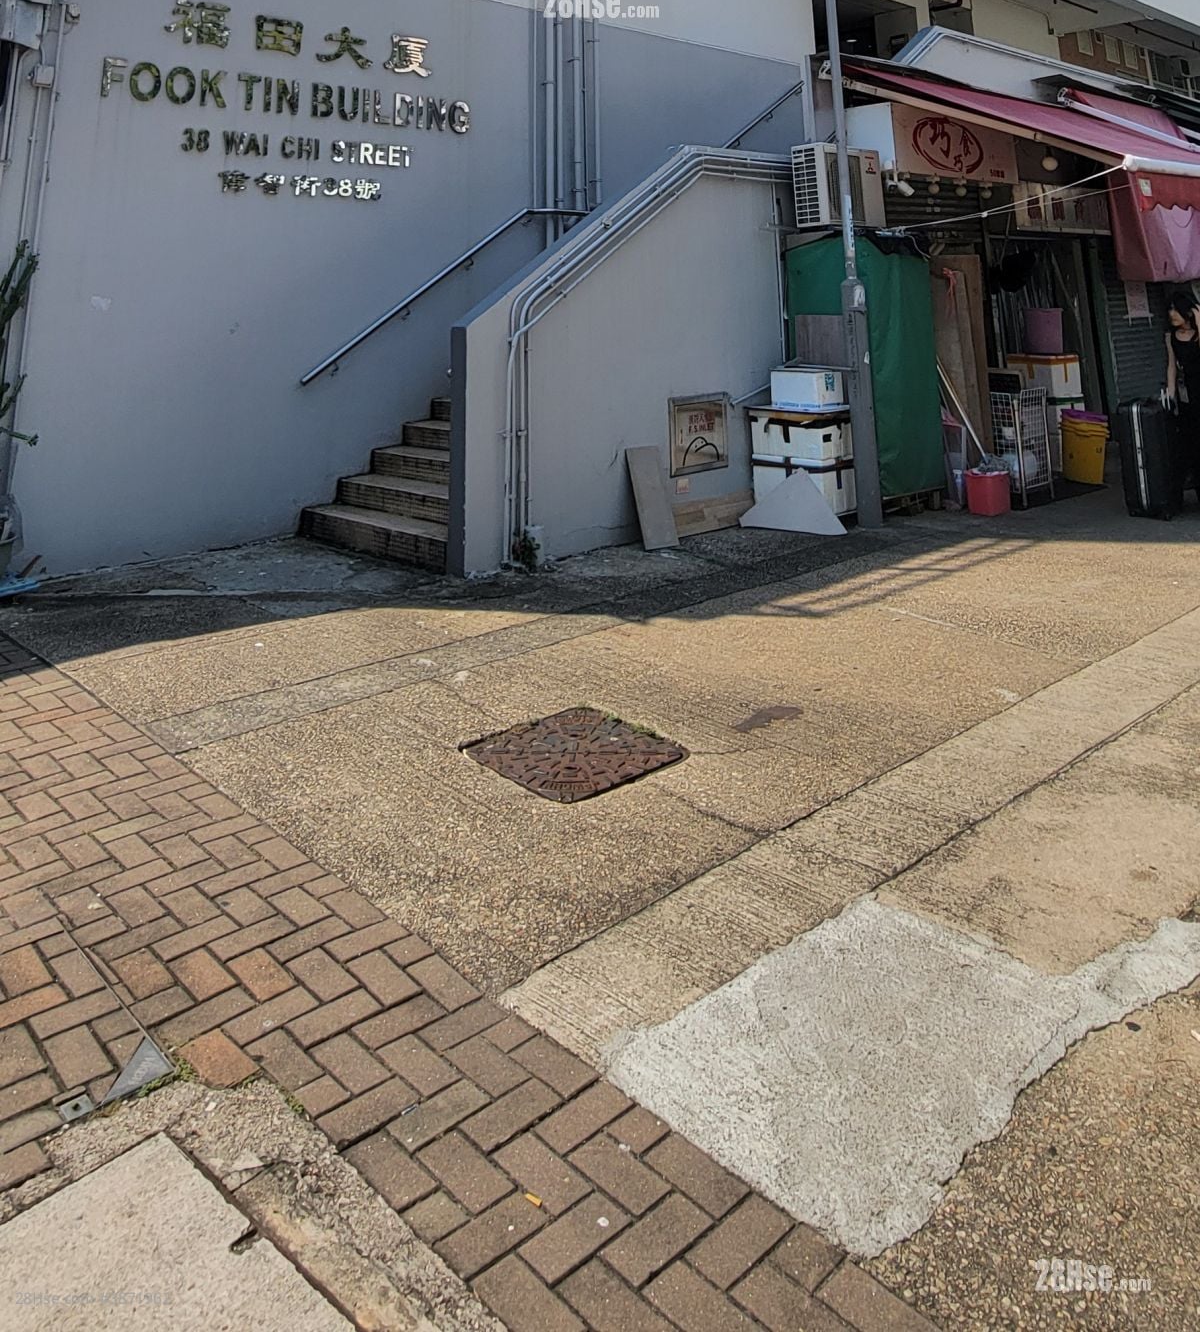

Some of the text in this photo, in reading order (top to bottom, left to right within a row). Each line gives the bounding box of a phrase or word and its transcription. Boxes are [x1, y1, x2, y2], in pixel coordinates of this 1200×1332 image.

[100, 56, 471, 135] FOOK TIN BUILDING
[180, 127, 416, 168] 38 WAI CHI STREET
